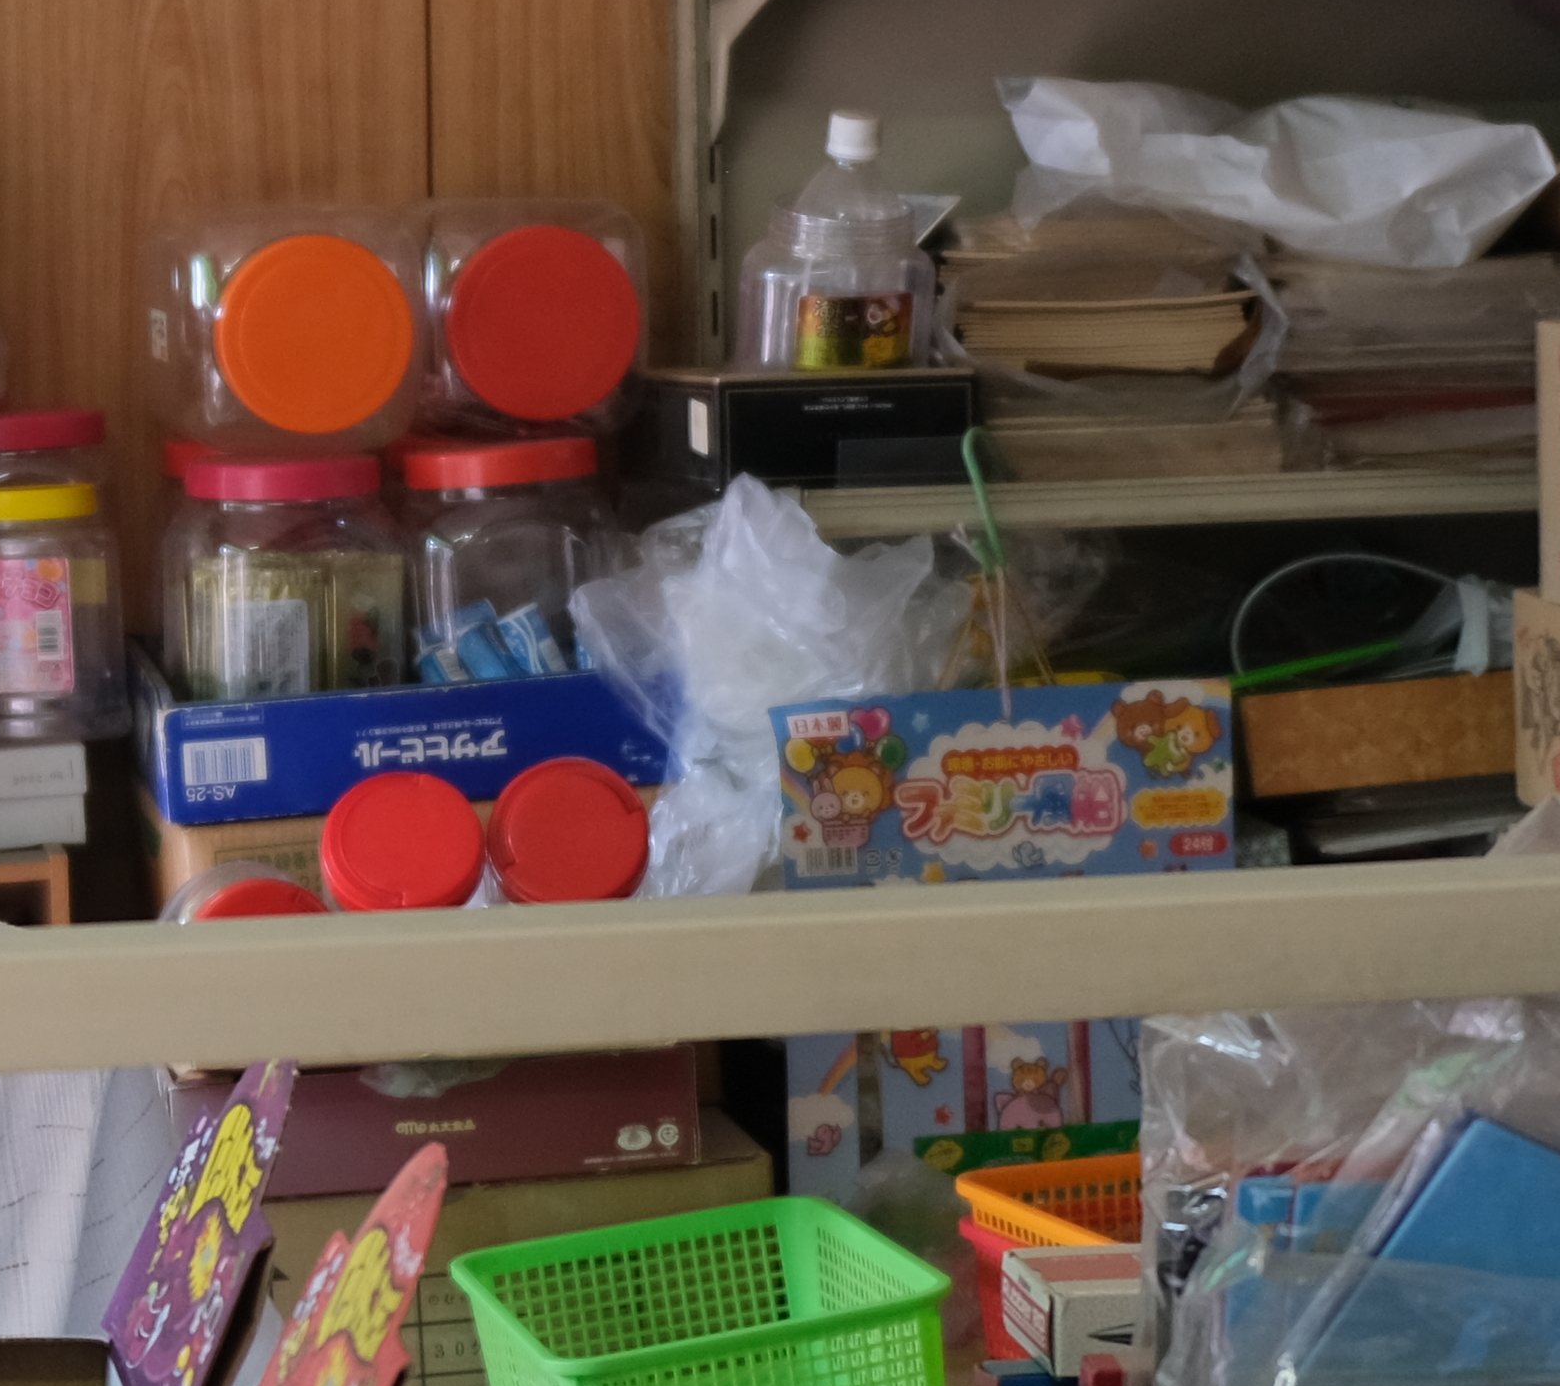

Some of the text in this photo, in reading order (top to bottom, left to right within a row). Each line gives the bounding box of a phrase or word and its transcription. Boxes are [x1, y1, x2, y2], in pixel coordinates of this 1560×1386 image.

[792, 715, 846, 736] 日本製
[353, 728, 509, 769] アサヒビール
[184, 782, 238, 804] AS-25
